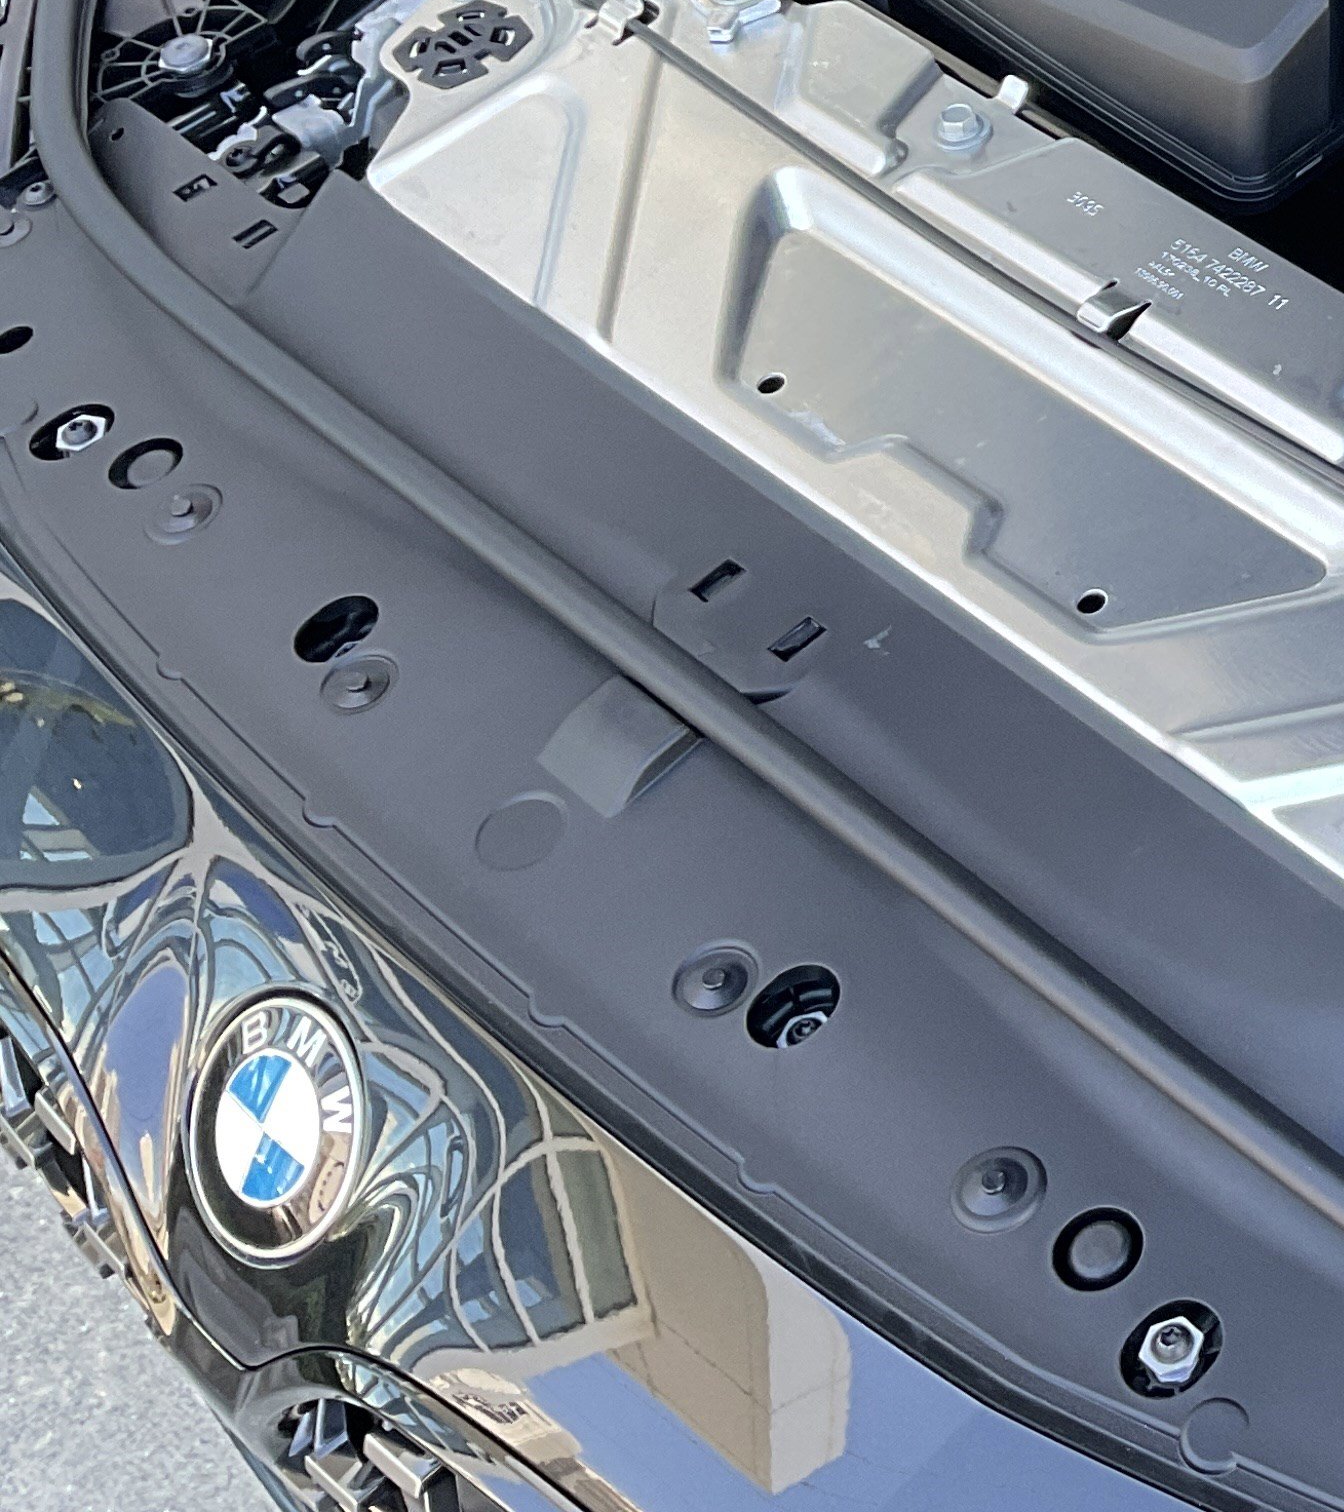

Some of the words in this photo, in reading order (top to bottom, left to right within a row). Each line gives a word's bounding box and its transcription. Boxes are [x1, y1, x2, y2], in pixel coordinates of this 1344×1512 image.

[1169, 237, 1209, 264] 5164
[1203, 258, 1267, 298] 7422287
[1266, 293, 1290, 311] 11
[1226, 246, 1270, 274] BMW
[240, 1008, 355, 1135] BMW
